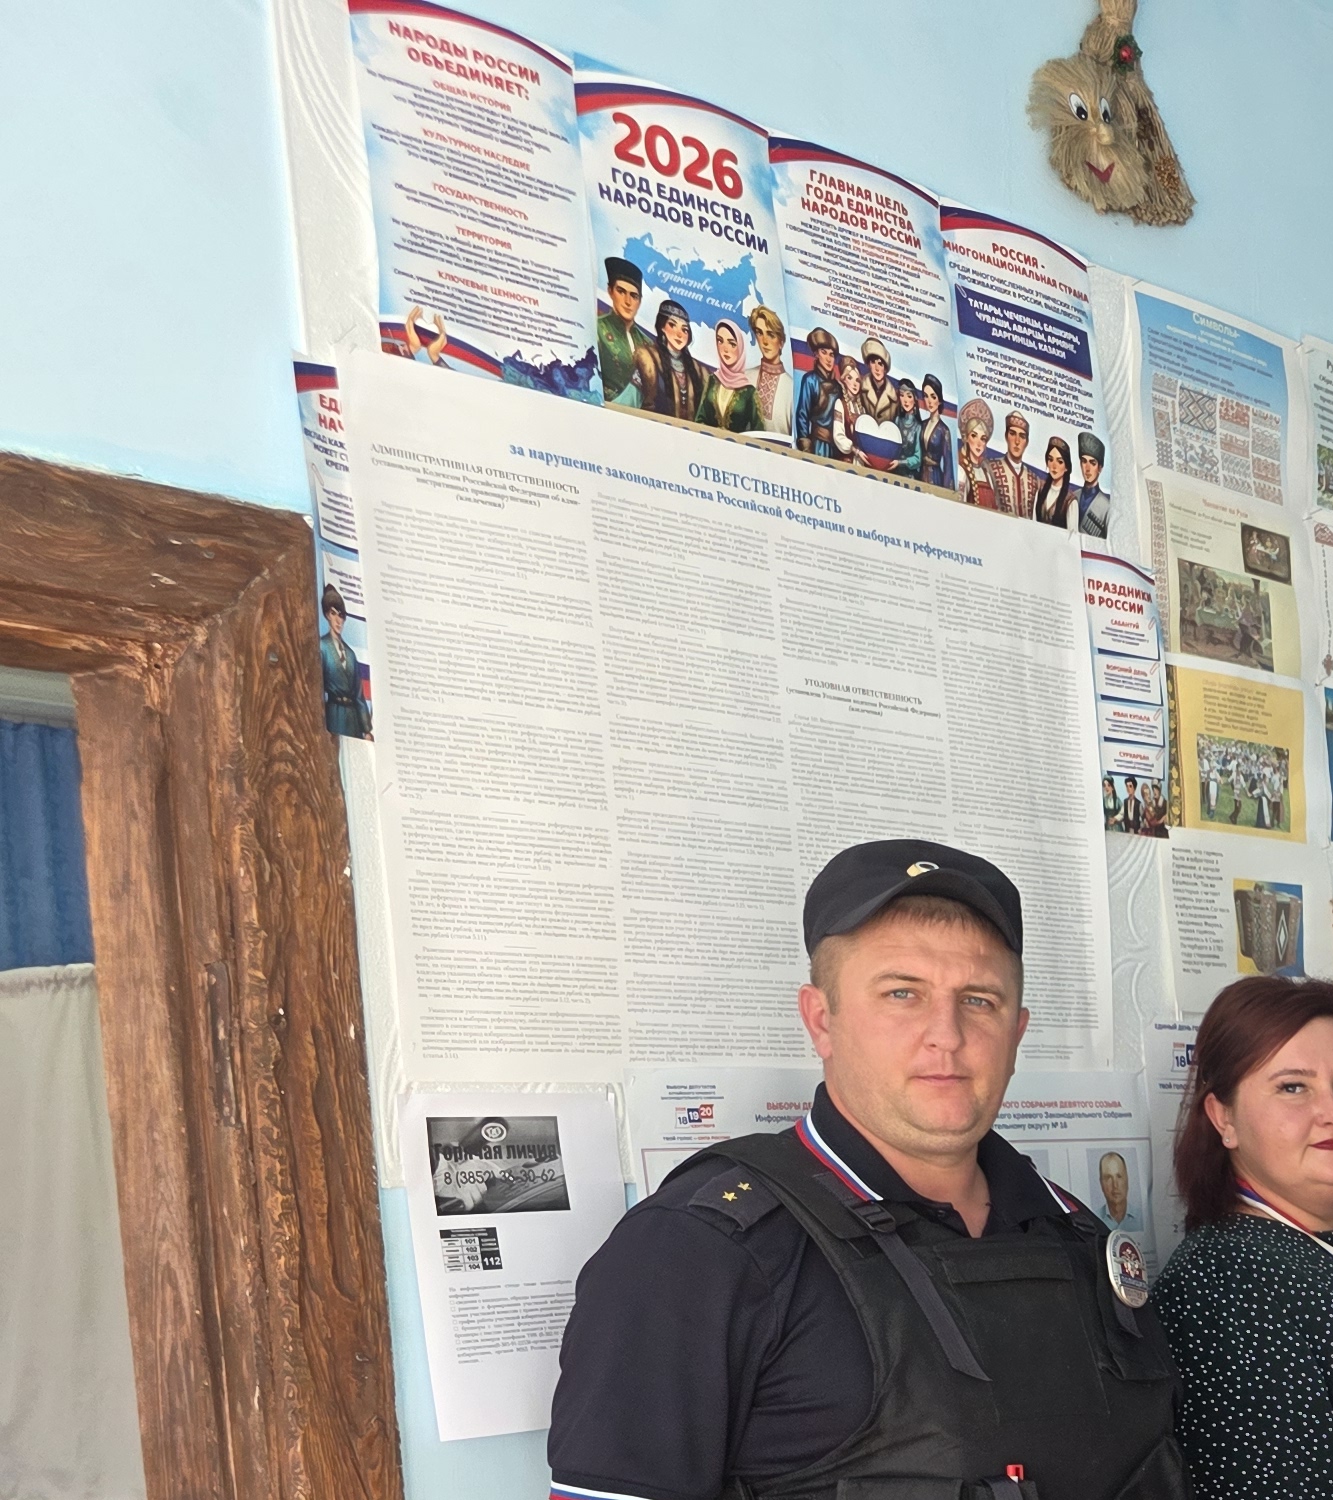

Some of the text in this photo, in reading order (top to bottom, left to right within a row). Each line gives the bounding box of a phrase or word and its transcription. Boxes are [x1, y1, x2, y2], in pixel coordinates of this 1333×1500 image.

[388, 20, 541, 86] НАРОДЫ РОССИИ
[407, 47, 530, 101] ОБЪЕДИНЯЕТ:
[432, 80, 512, 114] ОБЩАЯ ИСТОРИЯ
[422, 128, 531, 172] КУЛЬТУРНОЕ НАСЛЕДИЕ
[612, 112, 744, 200] 2026
[432, 182, 529, 222] ГОСУДАРСТВЕННОСТЬ
[611, 167, 755, 230] ГОД ЕДИНСТВА
[805, 183, 915, 234] ГОДА ЕДИНСТВА
[809, 169, 909, 217] ГЛАВНАЯ ЦЕЛЬ
[598, 182, 769, 255] НАРОДОВ РОССИИ
[801, 196, 922, 250] НАРОДОВ РОССИИ
[455, 225, 513, 251] ТЕРРИТОРИЯ
[942, 239, 1090, 303] МНОГОНАЦИОНАЛЬНАЯ СТРАНА
[991, 242, 1039, 269] РОССИЯ
[437, 270, 540, 307] КЛЮЧЕВЫЕ ЦЕННОСТИ
[656, 267, 715, 293] единстве
[668, 282, 743, 313] наша сила!
[967, 297, 1003, 316] ТАТАРЫ,
[975, 311, 1012, 332] ЧУВАШИ,
[1012, 323, 1046, 342] АВАРЦЫ,
[1038, 343, 1066, 359] КАЗАХИ
[1017, 367, 1059, 386] РОССИЙСКОЙ
[370, 442, 580, 495] АДМИНИСТРАТИВНАЯ ОТВЕТСТВЕННОСТЬ
[688, 462, 842, 514] ОТВЕТСТВЕННОСТЬ
[509, 444, 984, 567] за нарушение законодательства Российской Федерации о выборах и референдумах
[1087, 577, 1153, 603] ПРАЗДНИКИ
[1098, 595, 1144, 615] РОССИИ
[804, 678, 923, 706] УГОЛОВНАЯ ОТВЕТСТВЕННОСТЬ
[1175, 1055, 1187, 1067] 18
[678, 1106, 712, 1126] 18 19 20
[766, 1101, 801, 1111] ВЫБОРЫ
[1021, 1100, 1058, 1109] СОБРАНИЯ
[1059, 1101, 1094, 1110] ДЕВЯТОГО
[506, 1144, 559, 1160] линия
[444, 1171, 453, 1186] 8
[483, 1257, 502, 1267] 112
